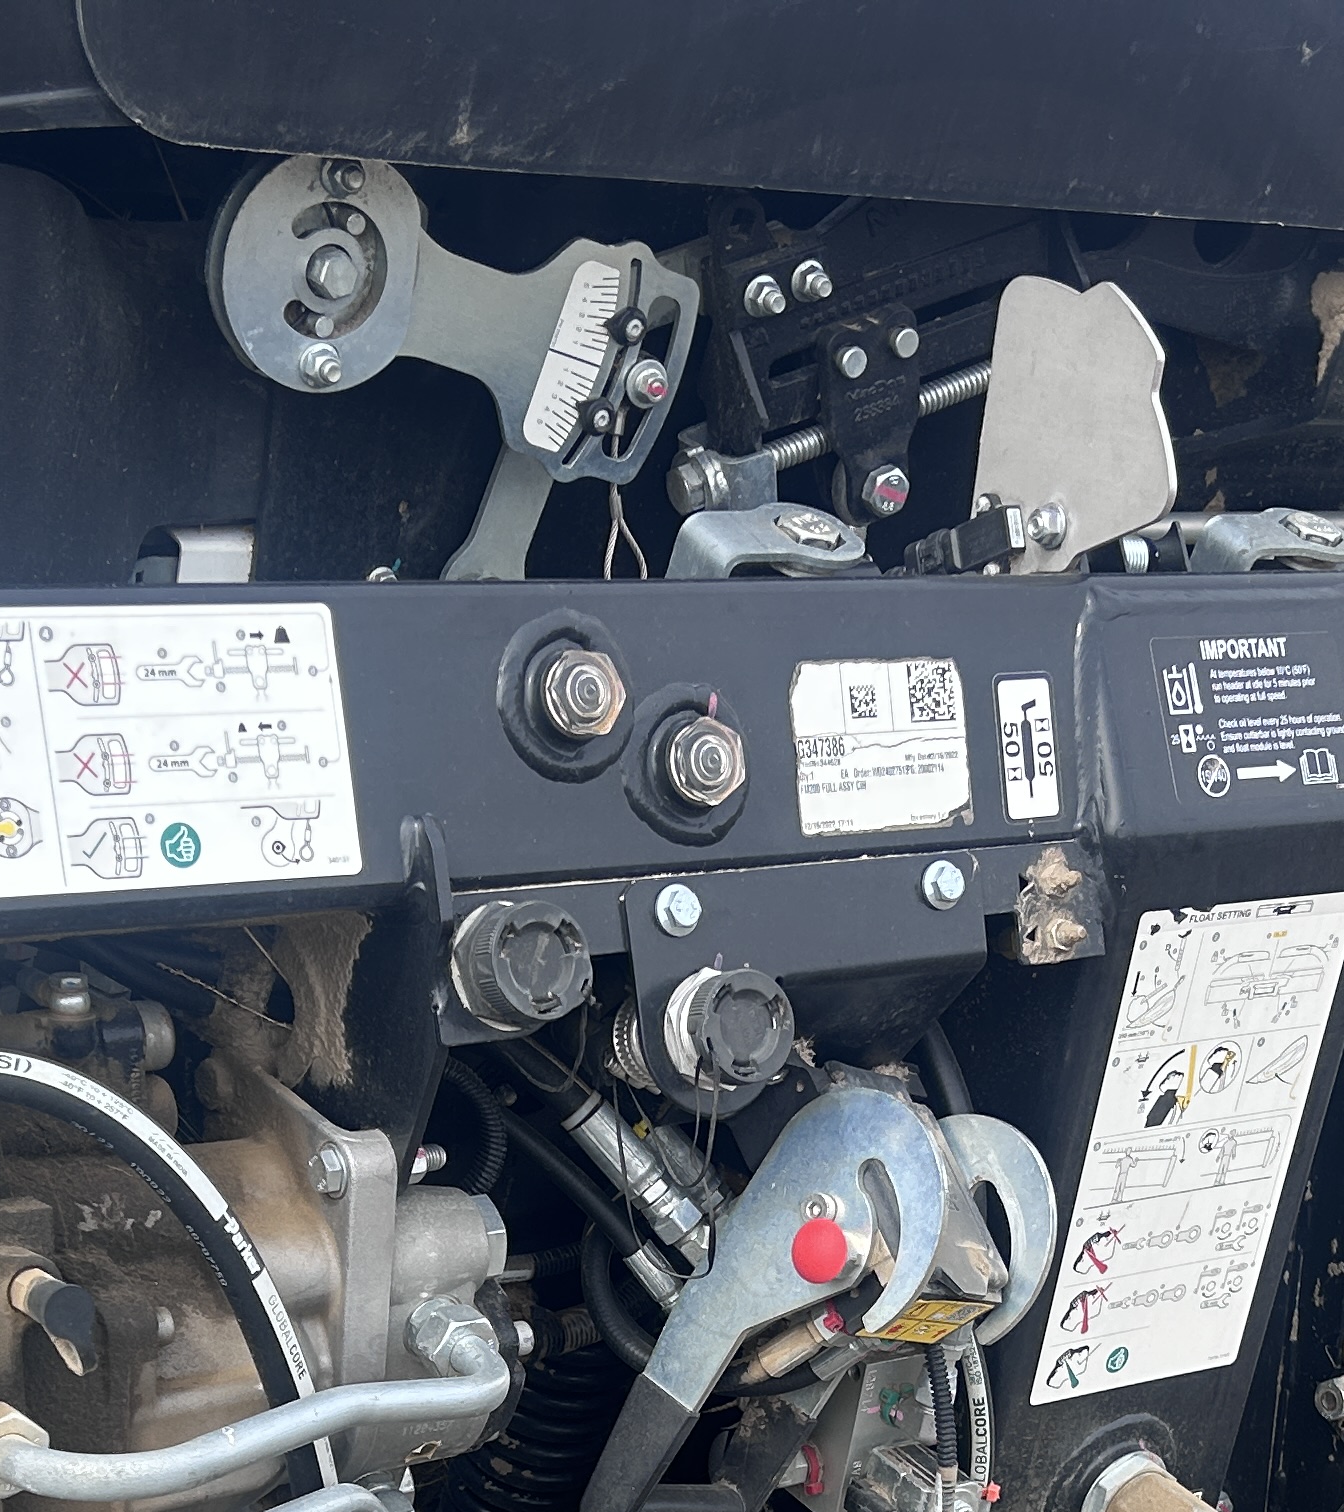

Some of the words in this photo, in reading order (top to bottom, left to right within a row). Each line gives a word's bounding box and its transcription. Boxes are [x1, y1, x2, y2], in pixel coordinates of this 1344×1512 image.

[1200, 637, 1286, 660] IMPORTANT
[144, 668, 156, 677] 24
[159, 669, 177, 677] mm
[1218, 719, 1238, 728] Check
[798, 737, 845, 758] G347386
[1004, 722, 1020, 757] 50
[157, 759, 168, 768] 24
[170, 760, 189, 768] mm
[1037, 742, 1054, 777] 50
[1189, 912, 1215, 923] FLOAT
[1217, 909, 1252, 921] SETTING
[224, 1215, 261, 1275] Parker
[268, 1294, 307, 1381] GLOBALCORE
[973, 1396, 988, 1487] LOBALCORE
